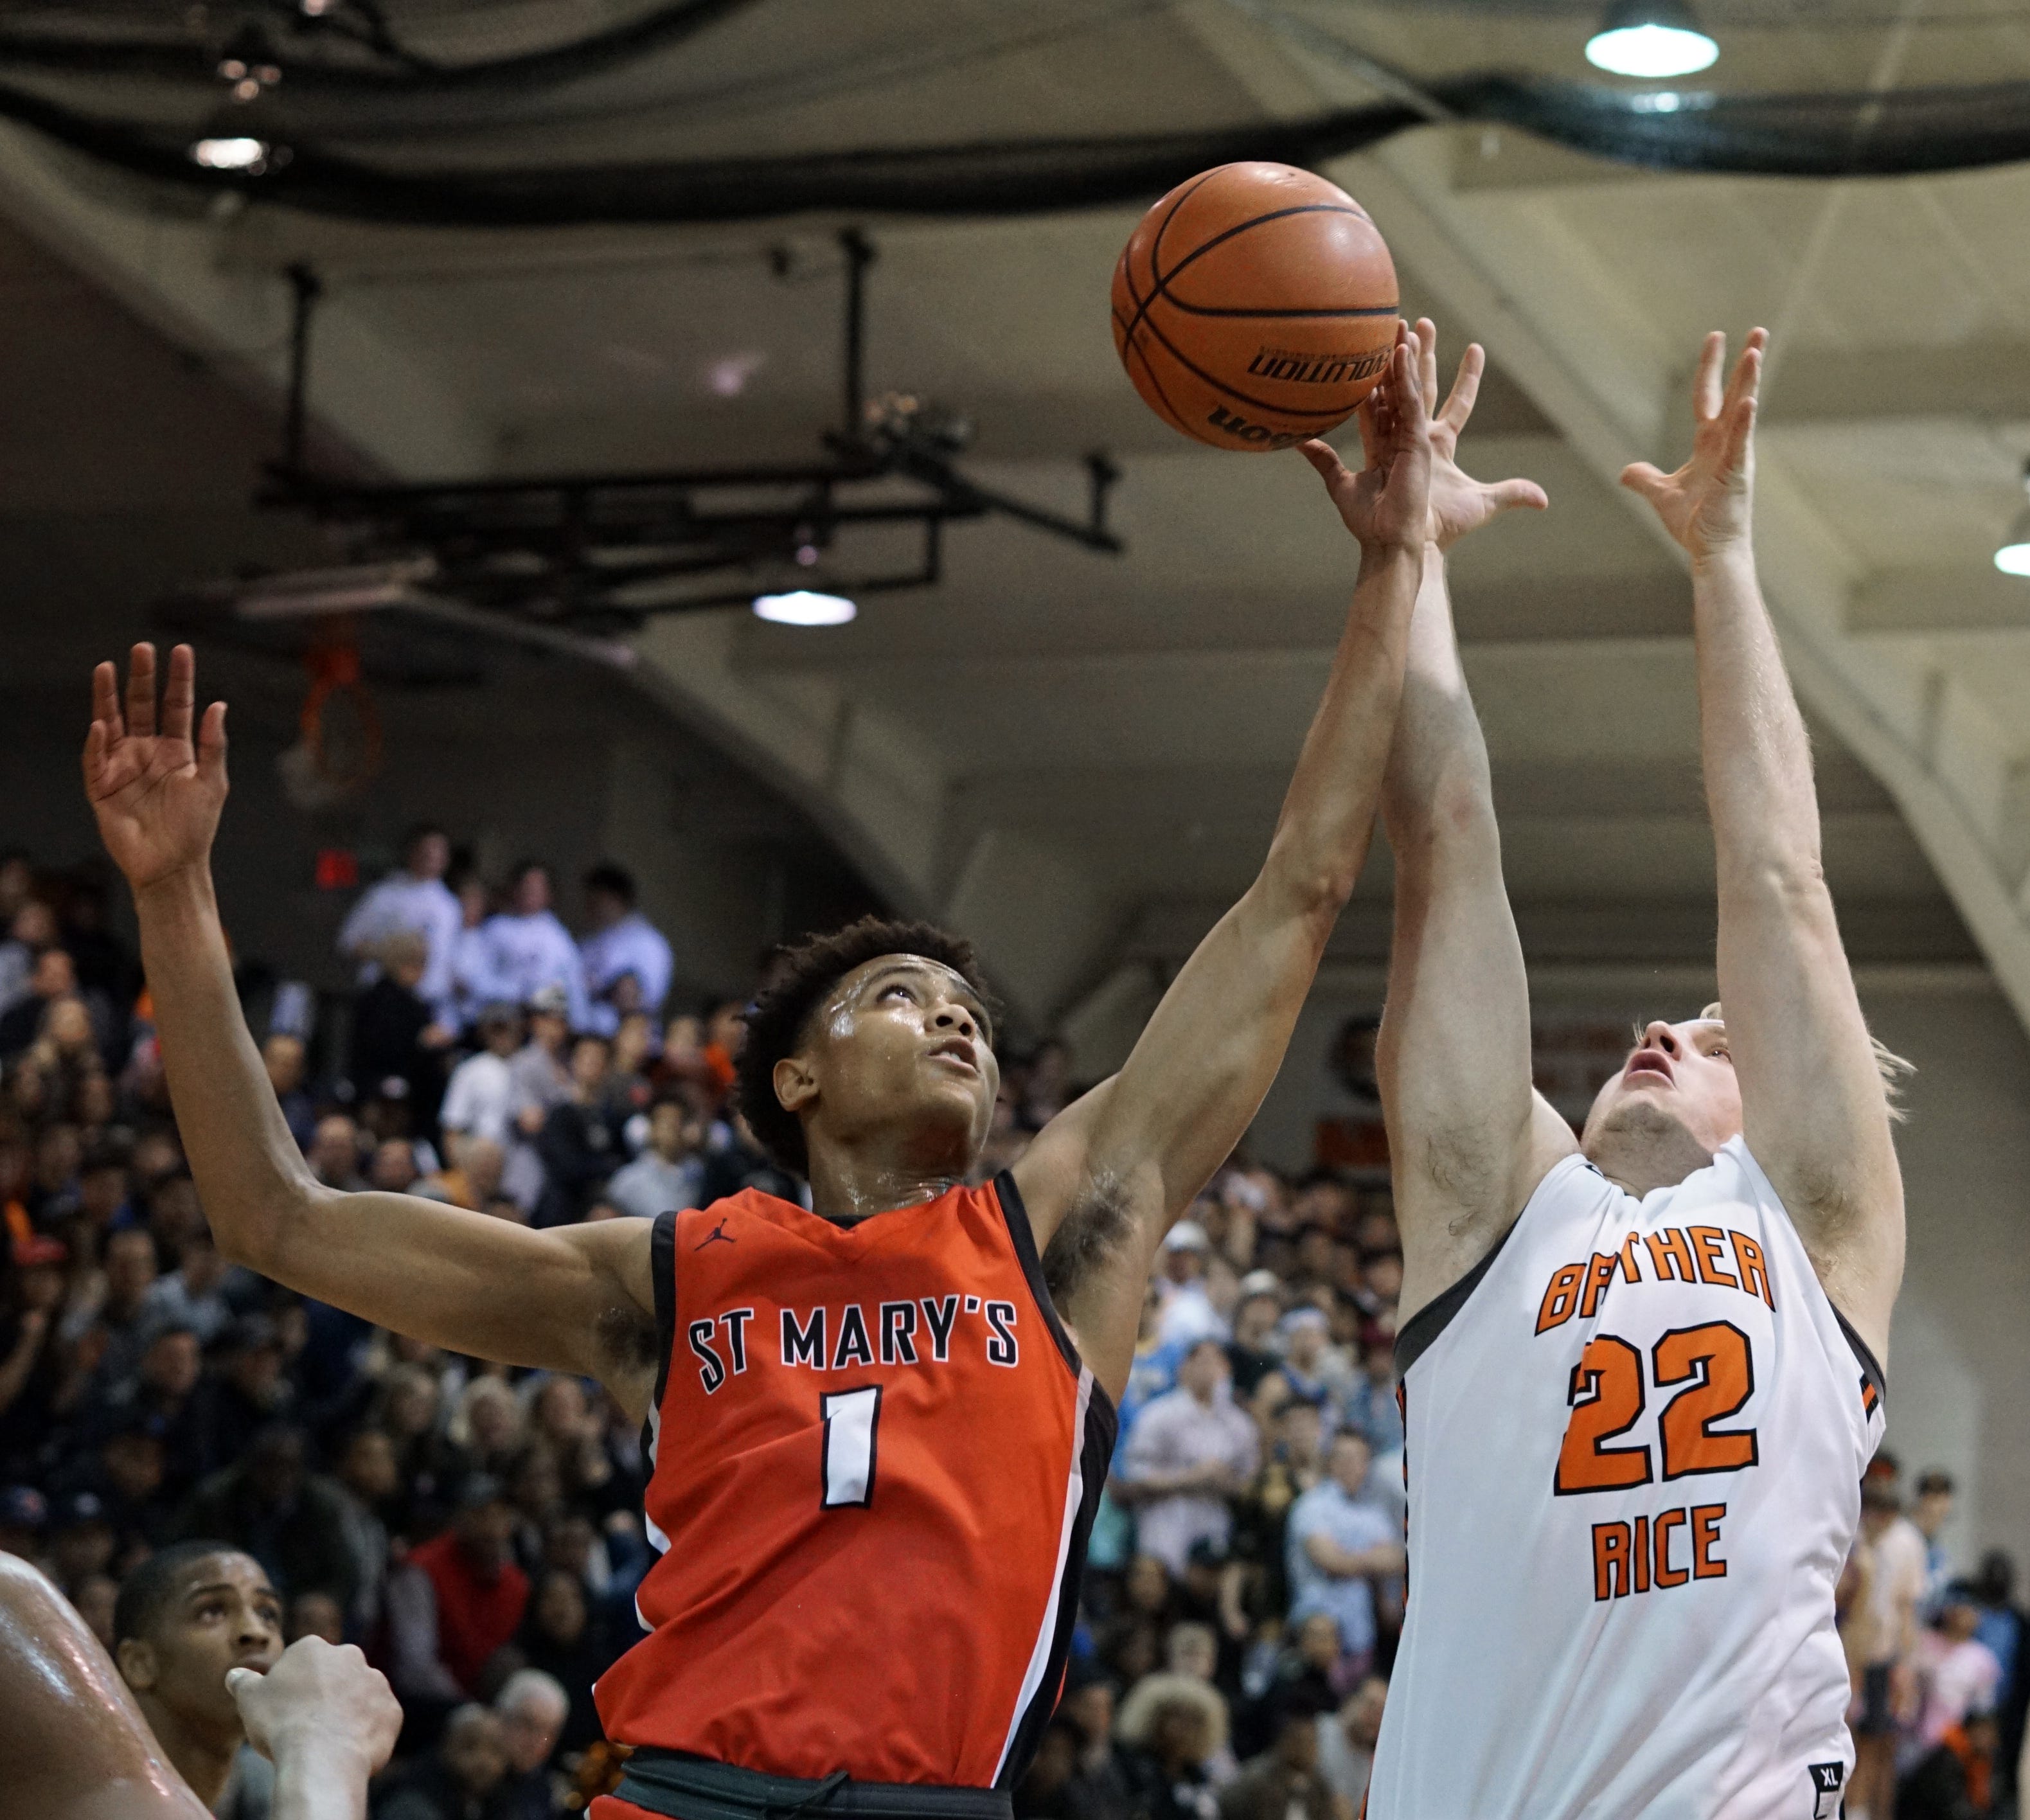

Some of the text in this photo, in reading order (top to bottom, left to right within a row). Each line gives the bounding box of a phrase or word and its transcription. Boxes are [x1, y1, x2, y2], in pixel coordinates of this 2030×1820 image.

[688, 1293, 1019, 1395] ST MARY'S
[819, 1384, 883, 1510] 1
[1553, 1319, 1759, 1497] 22
[1591, 1502, 1727, 1602] RICE
[1820, 1767, 1839, 1787] XL
